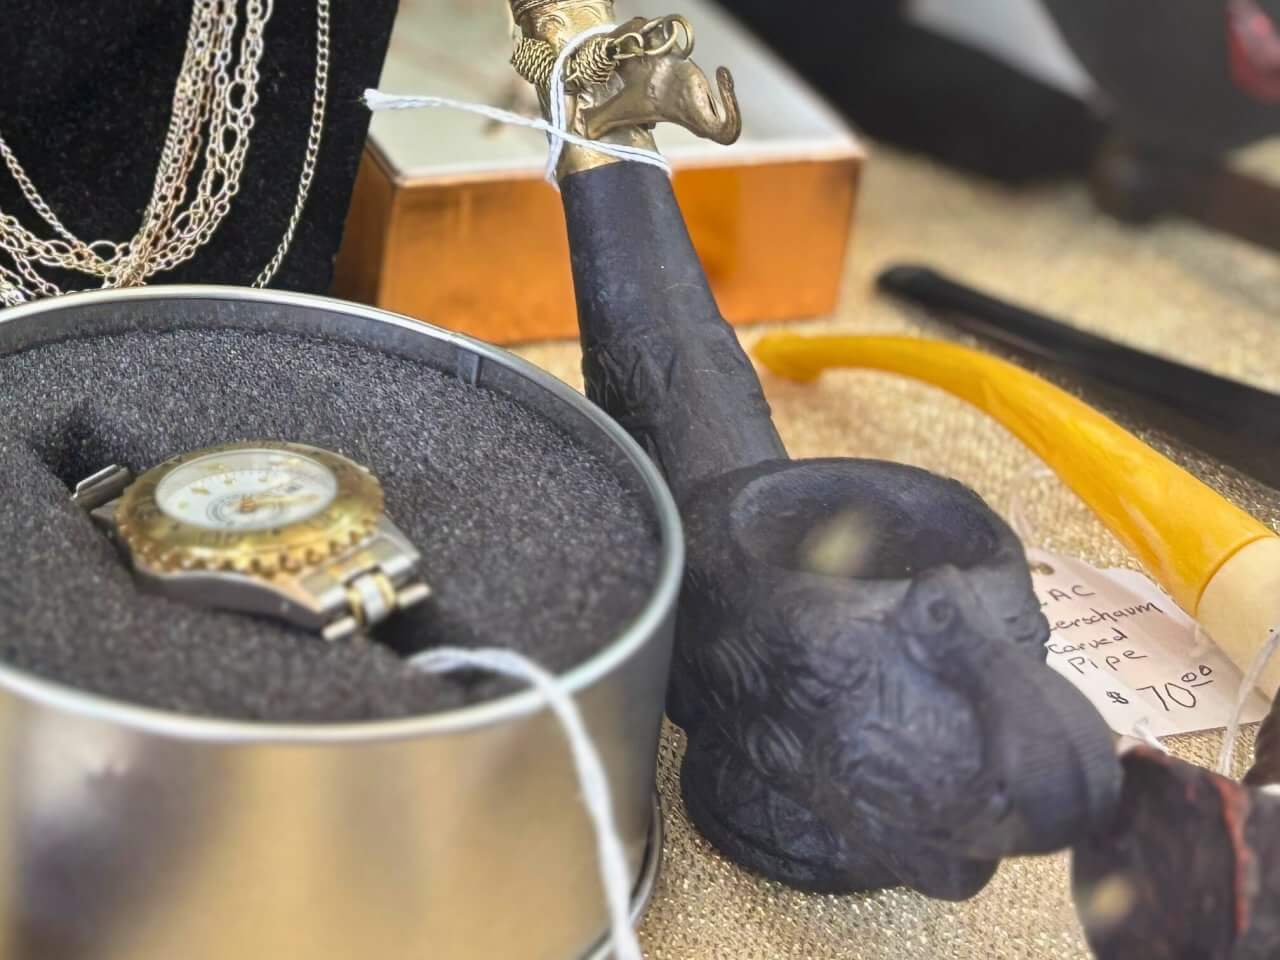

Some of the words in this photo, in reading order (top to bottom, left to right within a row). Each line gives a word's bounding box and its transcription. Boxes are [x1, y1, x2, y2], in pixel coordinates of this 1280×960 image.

[1041, 585, 1096, 606] AC
[1050, 601, 1163, 630] erschaum
[1067, 649, 1147, 674] Pipe
